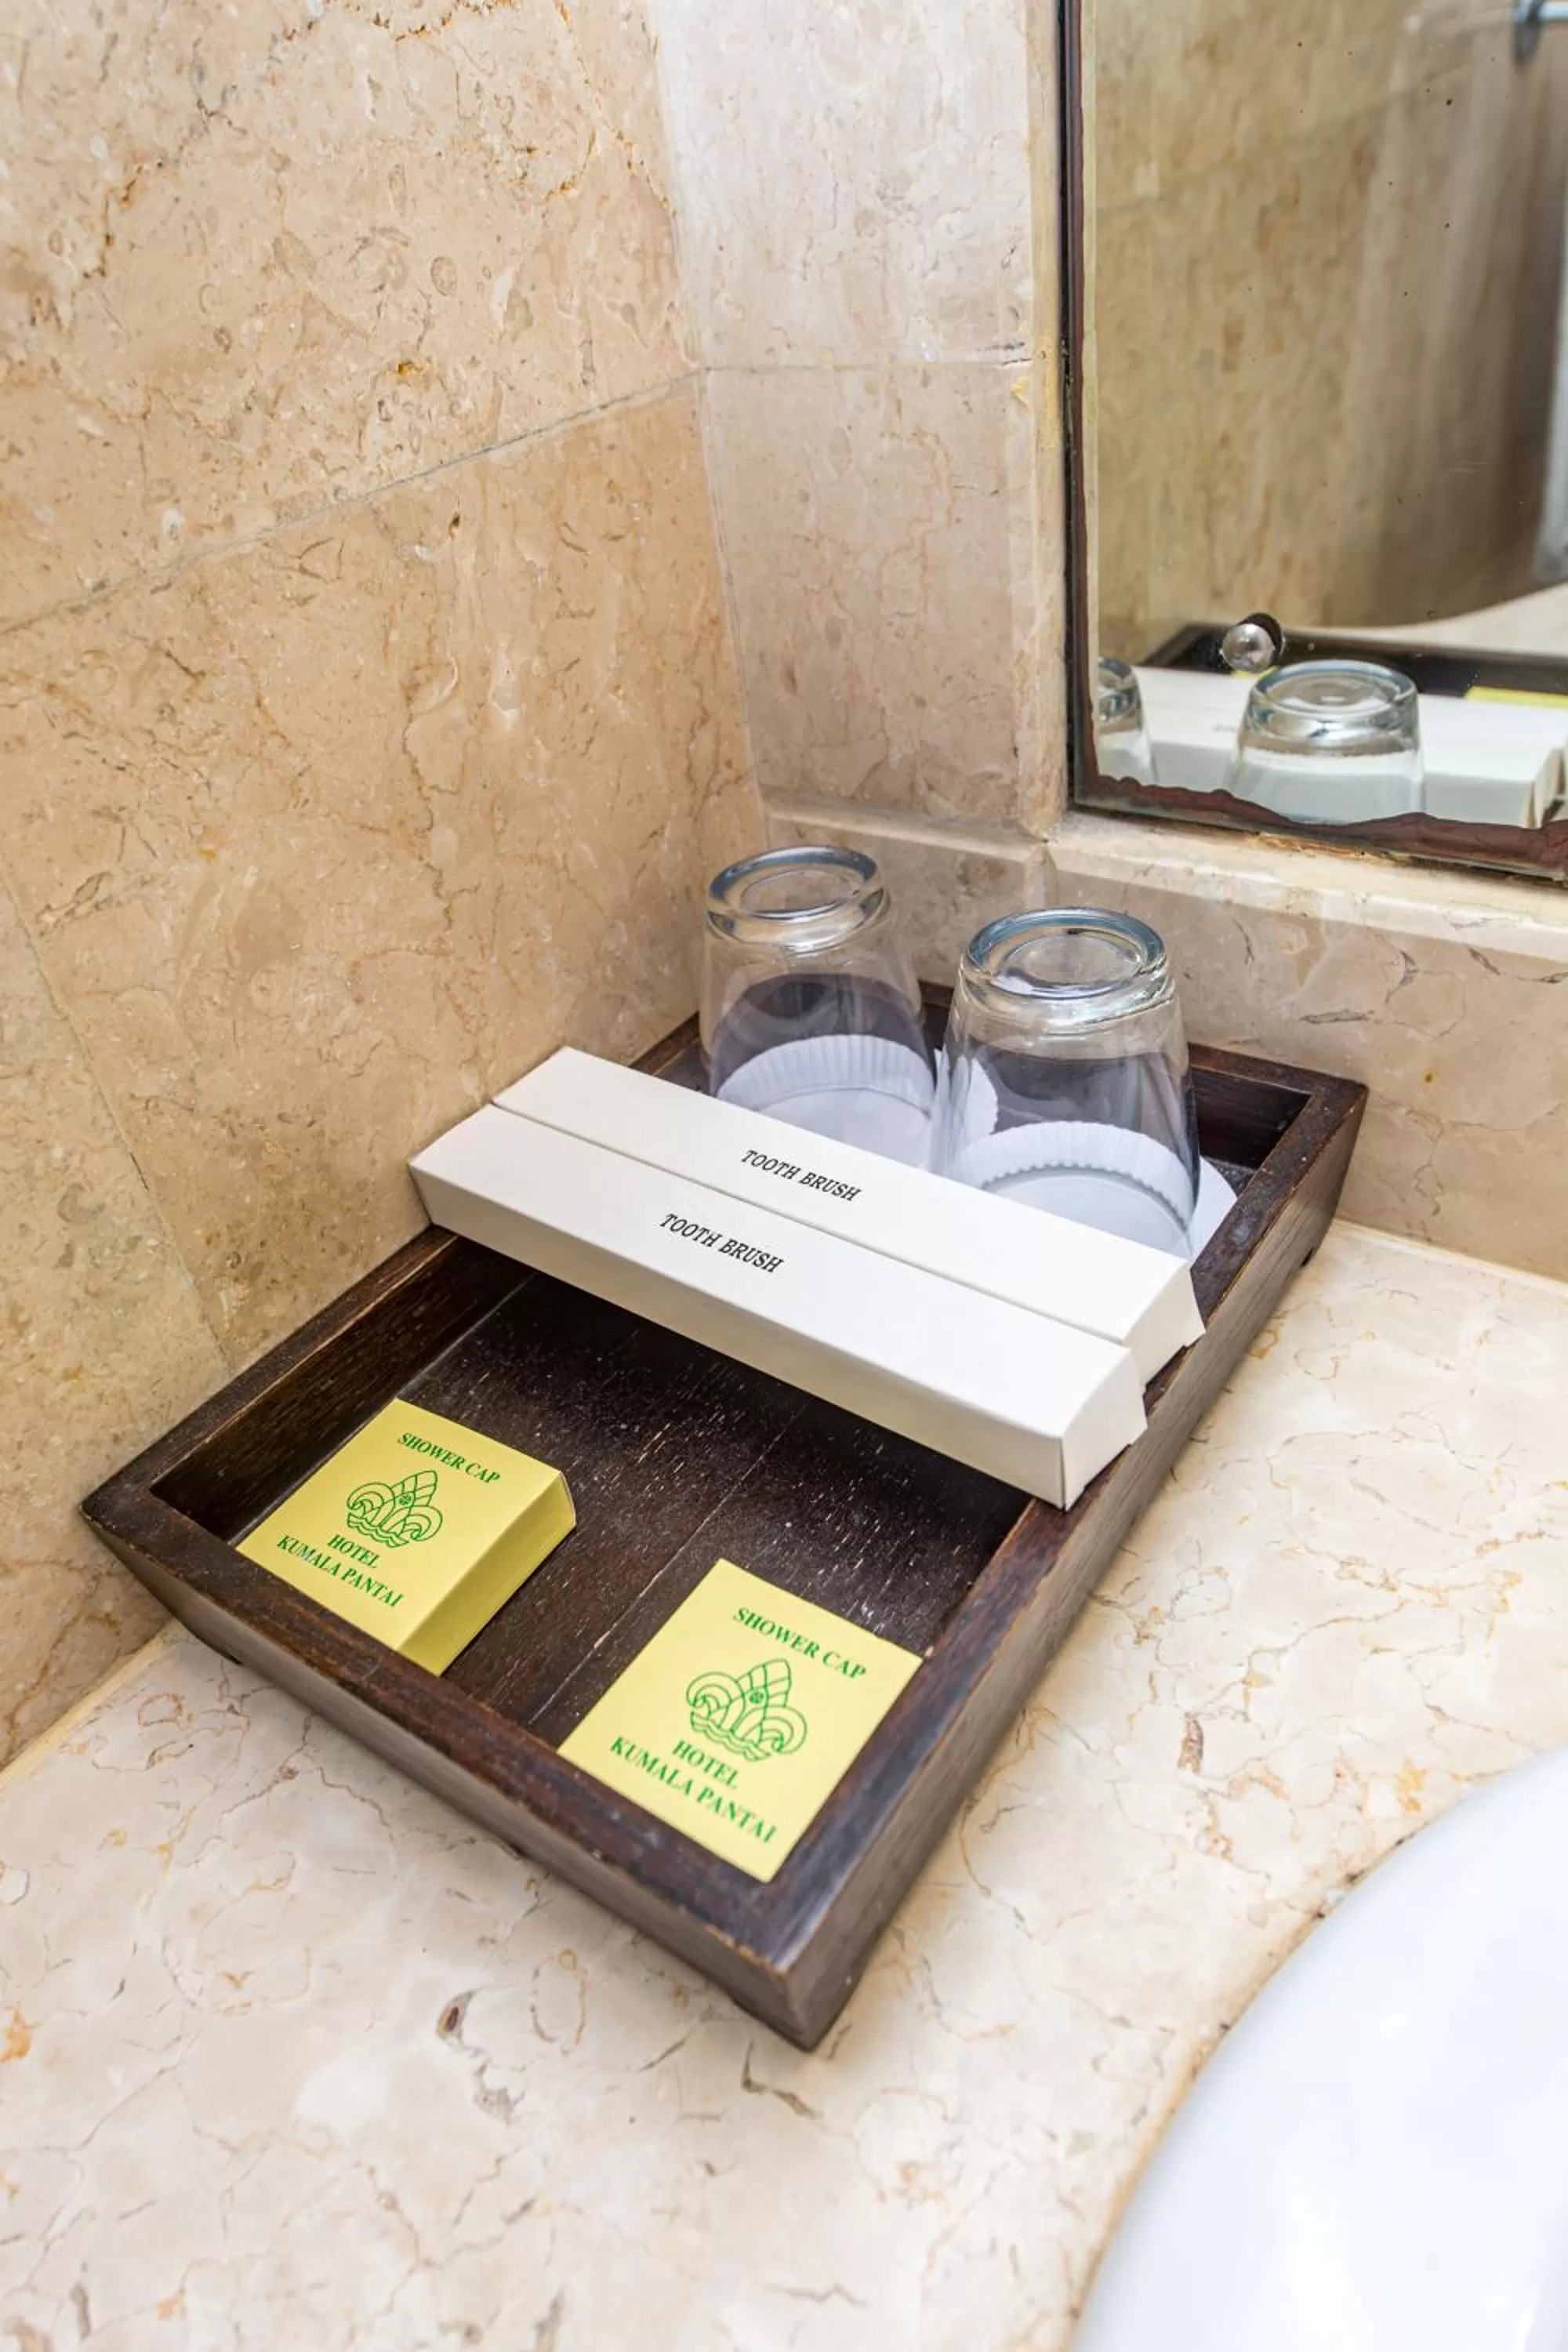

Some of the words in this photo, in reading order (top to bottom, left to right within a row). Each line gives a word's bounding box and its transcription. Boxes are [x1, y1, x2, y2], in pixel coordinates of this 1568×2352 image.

[741, 1149, 800, 1180] TOOTH
[800, 1171, 861, 1201] BRUSH
[659, 1214, 721, 1247] TOOTH
[719, 1239, 784, 1273] BRUSH
[397, 1432, 468, 1469] SHOWER
[465, 1462, 501, 1484] CAP
[276, 1534, 339, 1577] KUMALA
[343, 1568, 405, 1608] PANTAI
[327, 1534, 381, 1569] HOTEL
[732, 1607, 822, 1658] SHOWER
[822, 1651, 866, 1680] CAP
[609, 1736, 693, 1797] KUMALA
[696, 1785, 778, 1844] PANTAI
[672, 1740, 739, 1790] HOTEL
